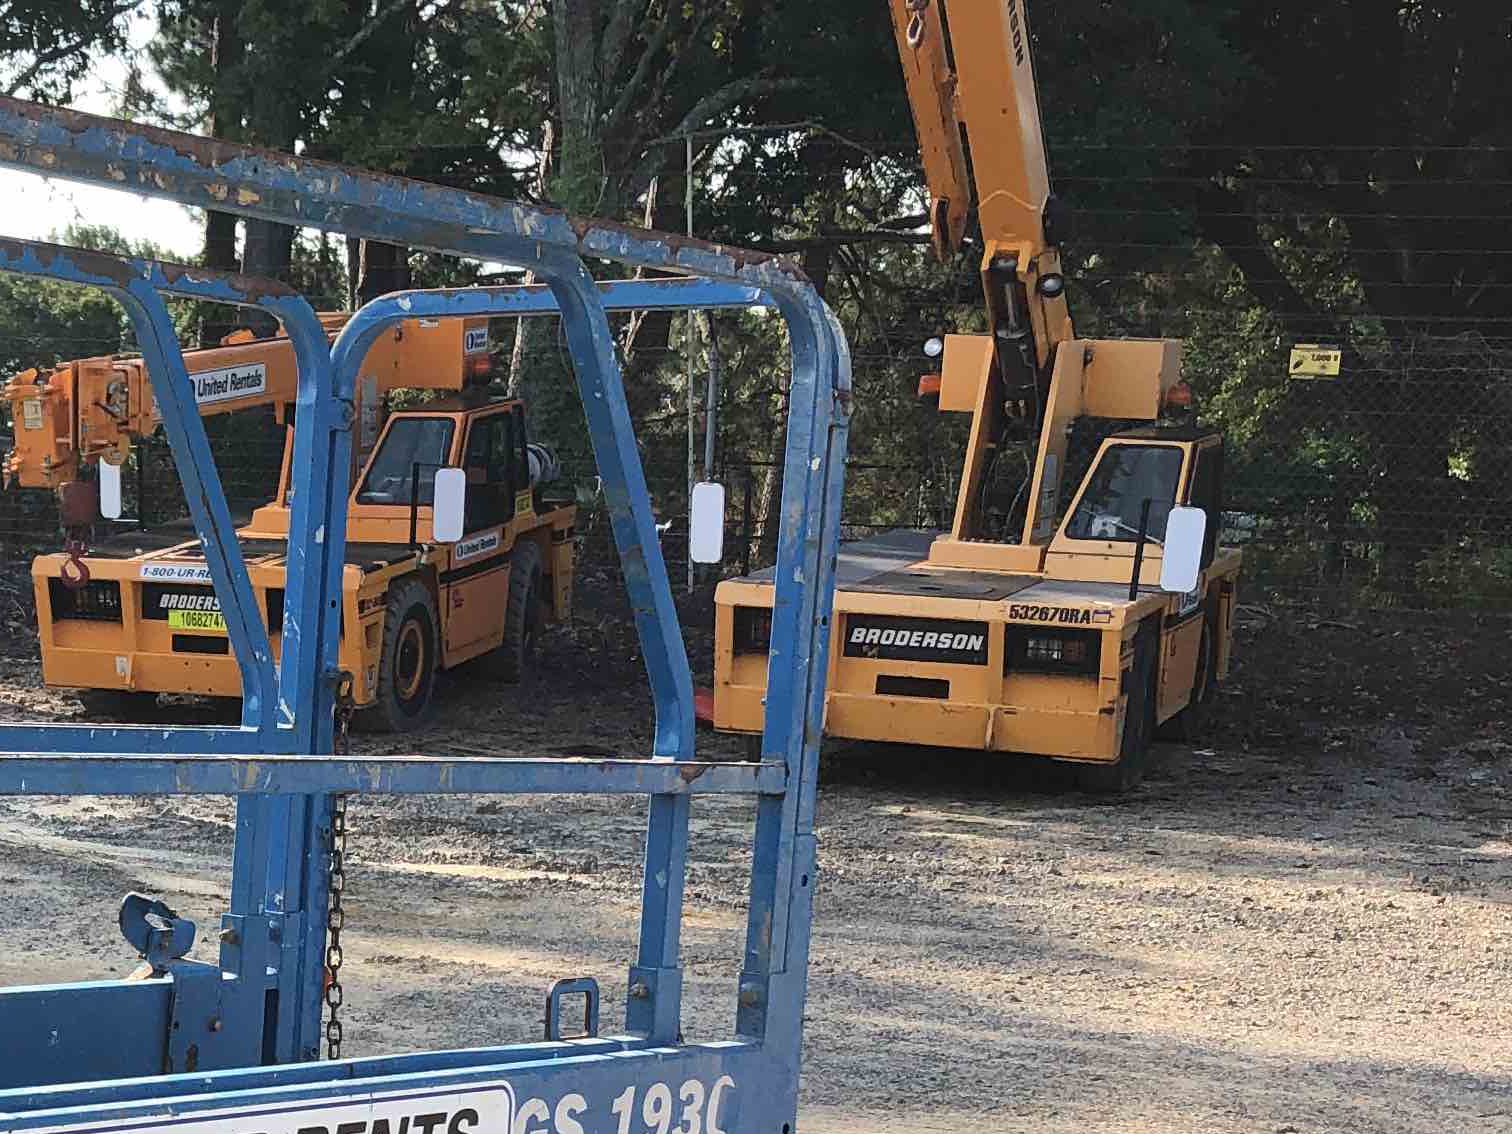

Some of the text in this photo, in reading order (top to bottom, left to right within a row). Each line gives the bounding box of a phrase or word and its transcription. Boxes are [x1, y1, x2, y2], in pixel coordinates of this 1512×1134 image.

[197, 369, 263, 397] United Rentals
[143, 567, 210, 578] 1-800-UR-RE
[160, 594, 220, 610] BRODERS
[849, 627, 984, 651] BRODERSON
